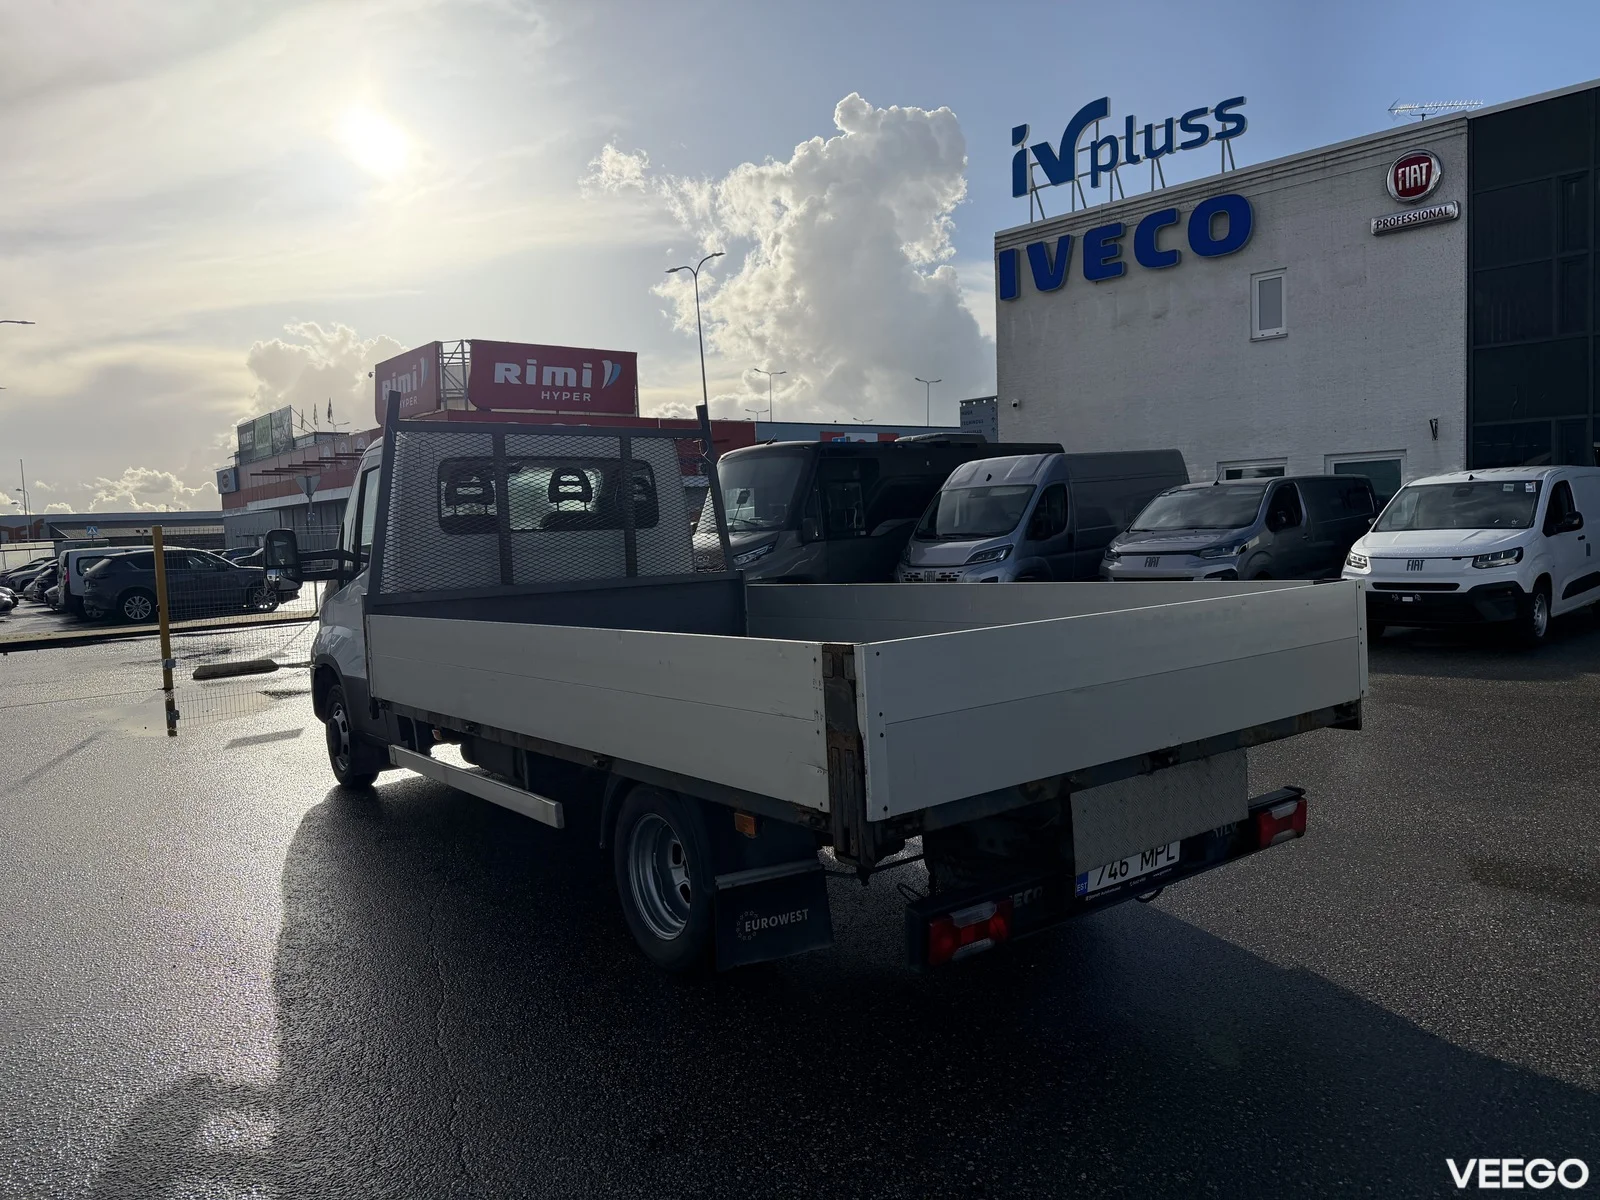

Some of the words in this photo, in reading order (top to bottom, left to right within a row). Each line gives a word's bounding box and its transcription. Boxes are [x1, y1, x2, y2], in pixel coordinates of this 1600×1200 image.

[1398, 162, 1429, 191] FIAT
[1376, 206, 1450, 229] PROFESSIONAL
[999, 193, 1253, 300] IVECO
[494, 359, 592, 388] Rimi
[541, 391, 592, 402] HYPER
[1406, 560, 1425, 572] FIAT
[1140, 843, 1175, 871] MPL
[1076, 881, 1088, 892] EST
[745, 908, 809, 933] EUROWEST
